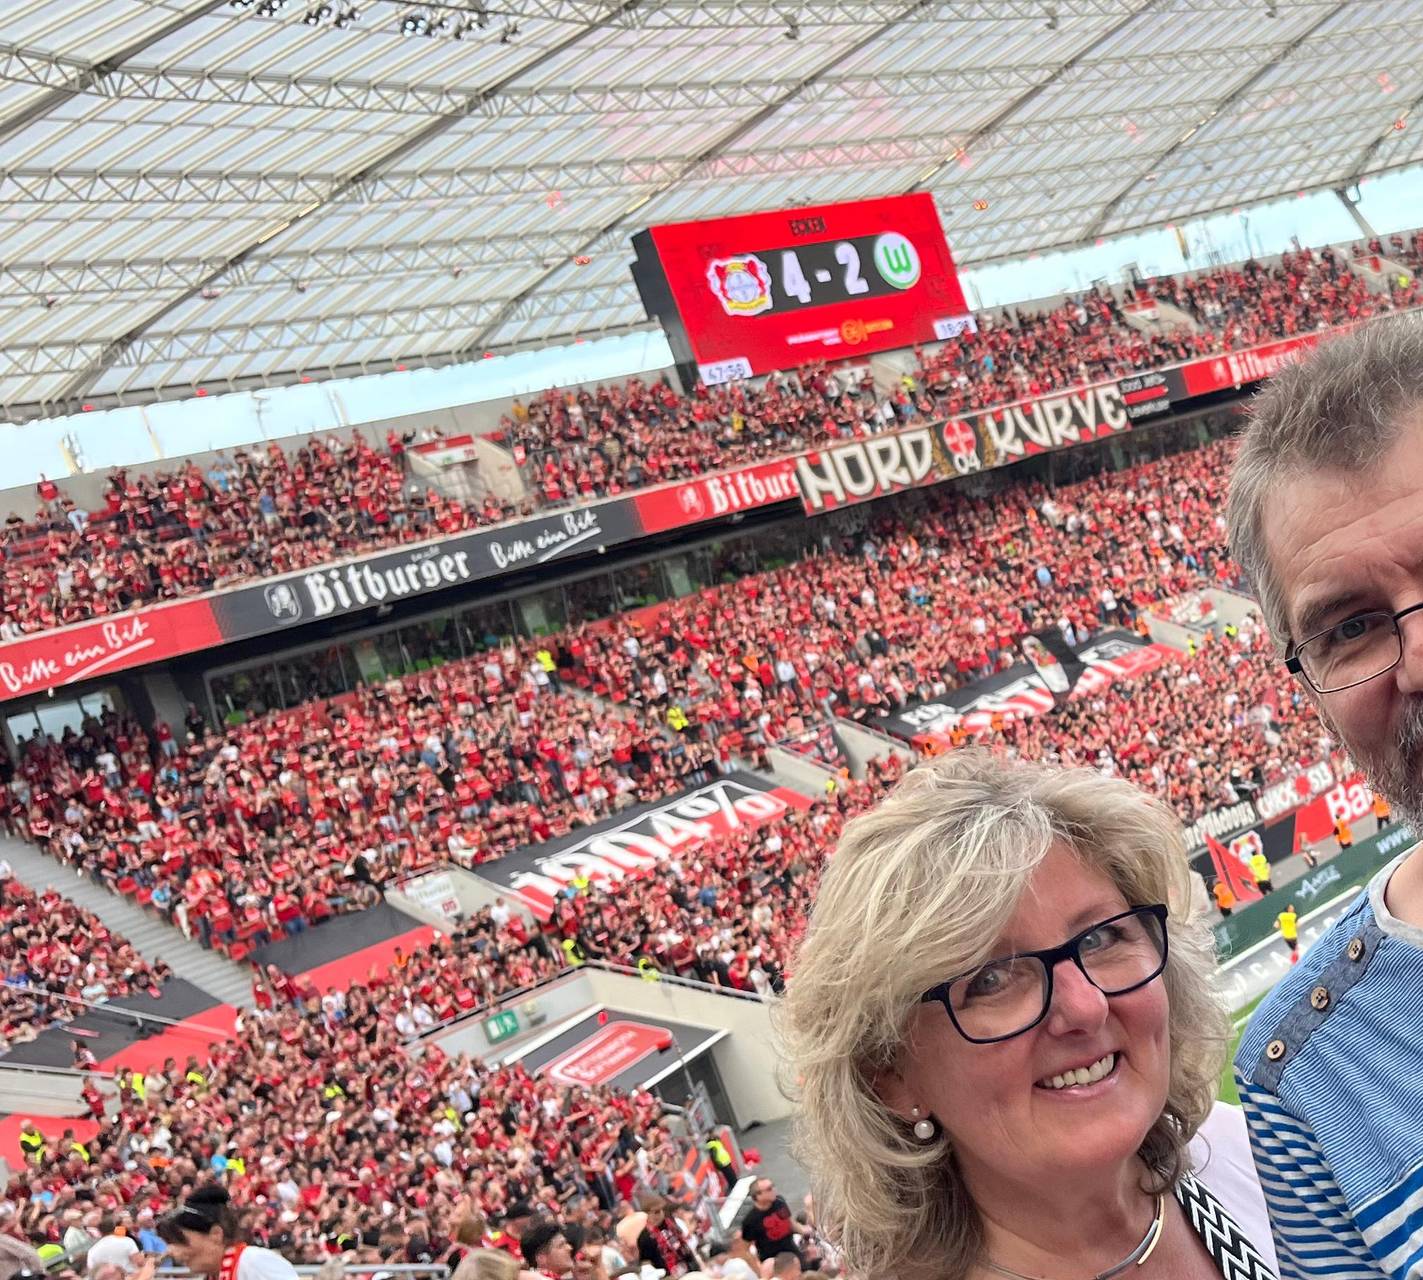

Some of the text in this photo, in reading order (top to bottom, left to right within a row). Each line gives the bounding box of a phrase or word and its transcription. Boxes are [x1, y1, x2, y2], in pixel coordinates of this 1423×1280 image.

[782, 250, 812, 304] 4
[835, 241, 869, 295] 2
[796, 384, 1129, 508] NORD 04 KURVE
[304, 550, 472, 617] Bitburger
[0, 615, 150, 693] Bitte ein Bit
